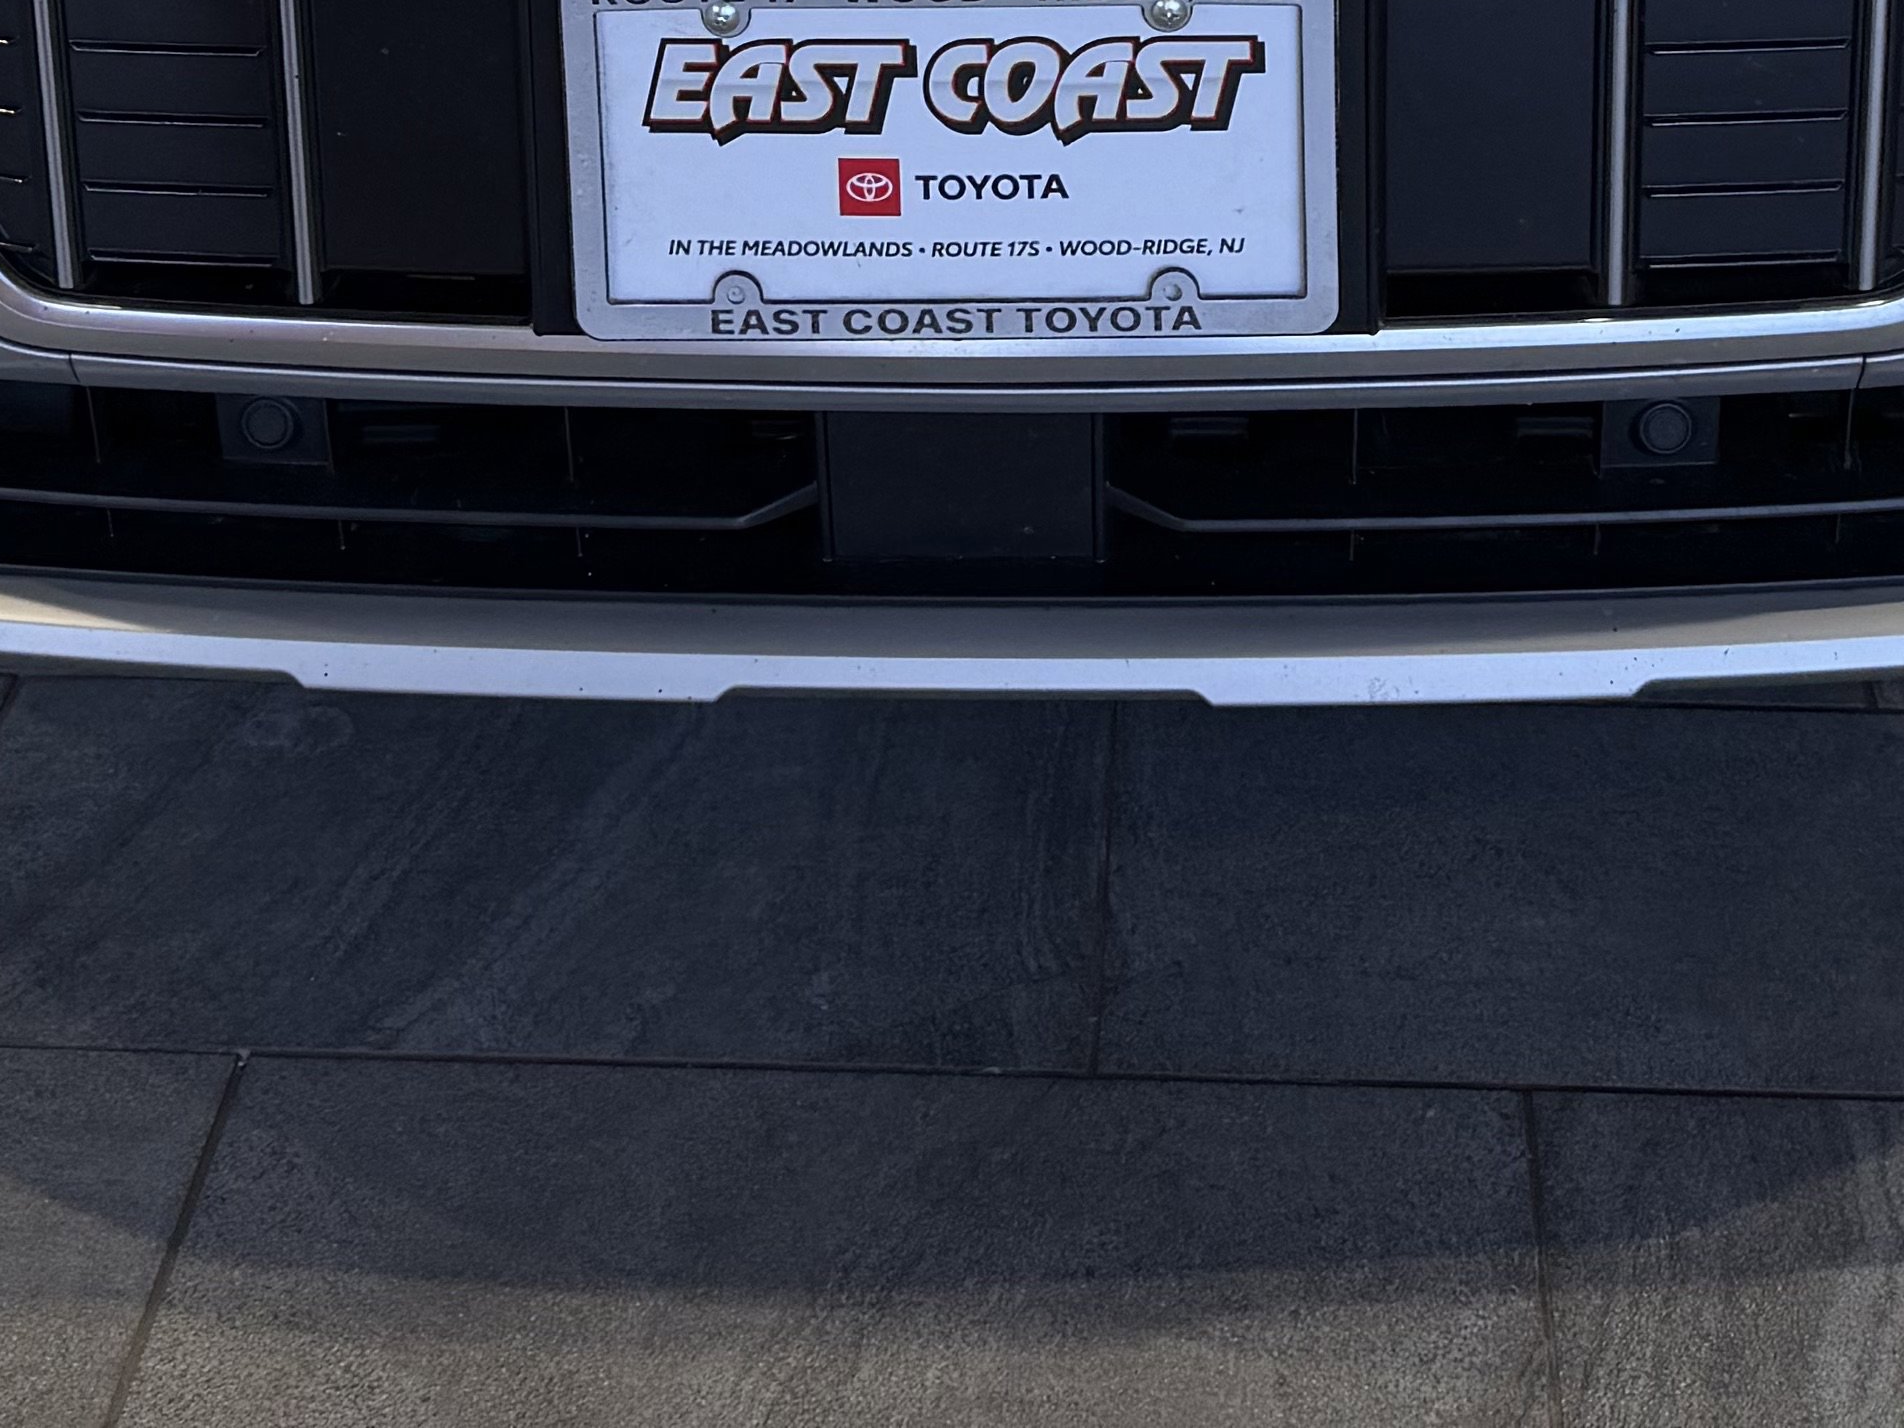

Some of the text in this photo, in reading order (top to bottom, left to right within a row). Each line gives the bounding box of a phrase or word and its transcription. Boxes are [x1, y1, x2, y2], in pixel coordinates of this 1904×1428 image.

[641, 35, 1266, 147] EAST COAST
[914, 173, 1070, 201] TOYOTA
[668, 237, 1246, 257] IN THE MEADOWLANDS ROUTE 17S WOOD-RIDGE, NJ
[710, 305, 1202, 335] EAST COAST TOYOTA
